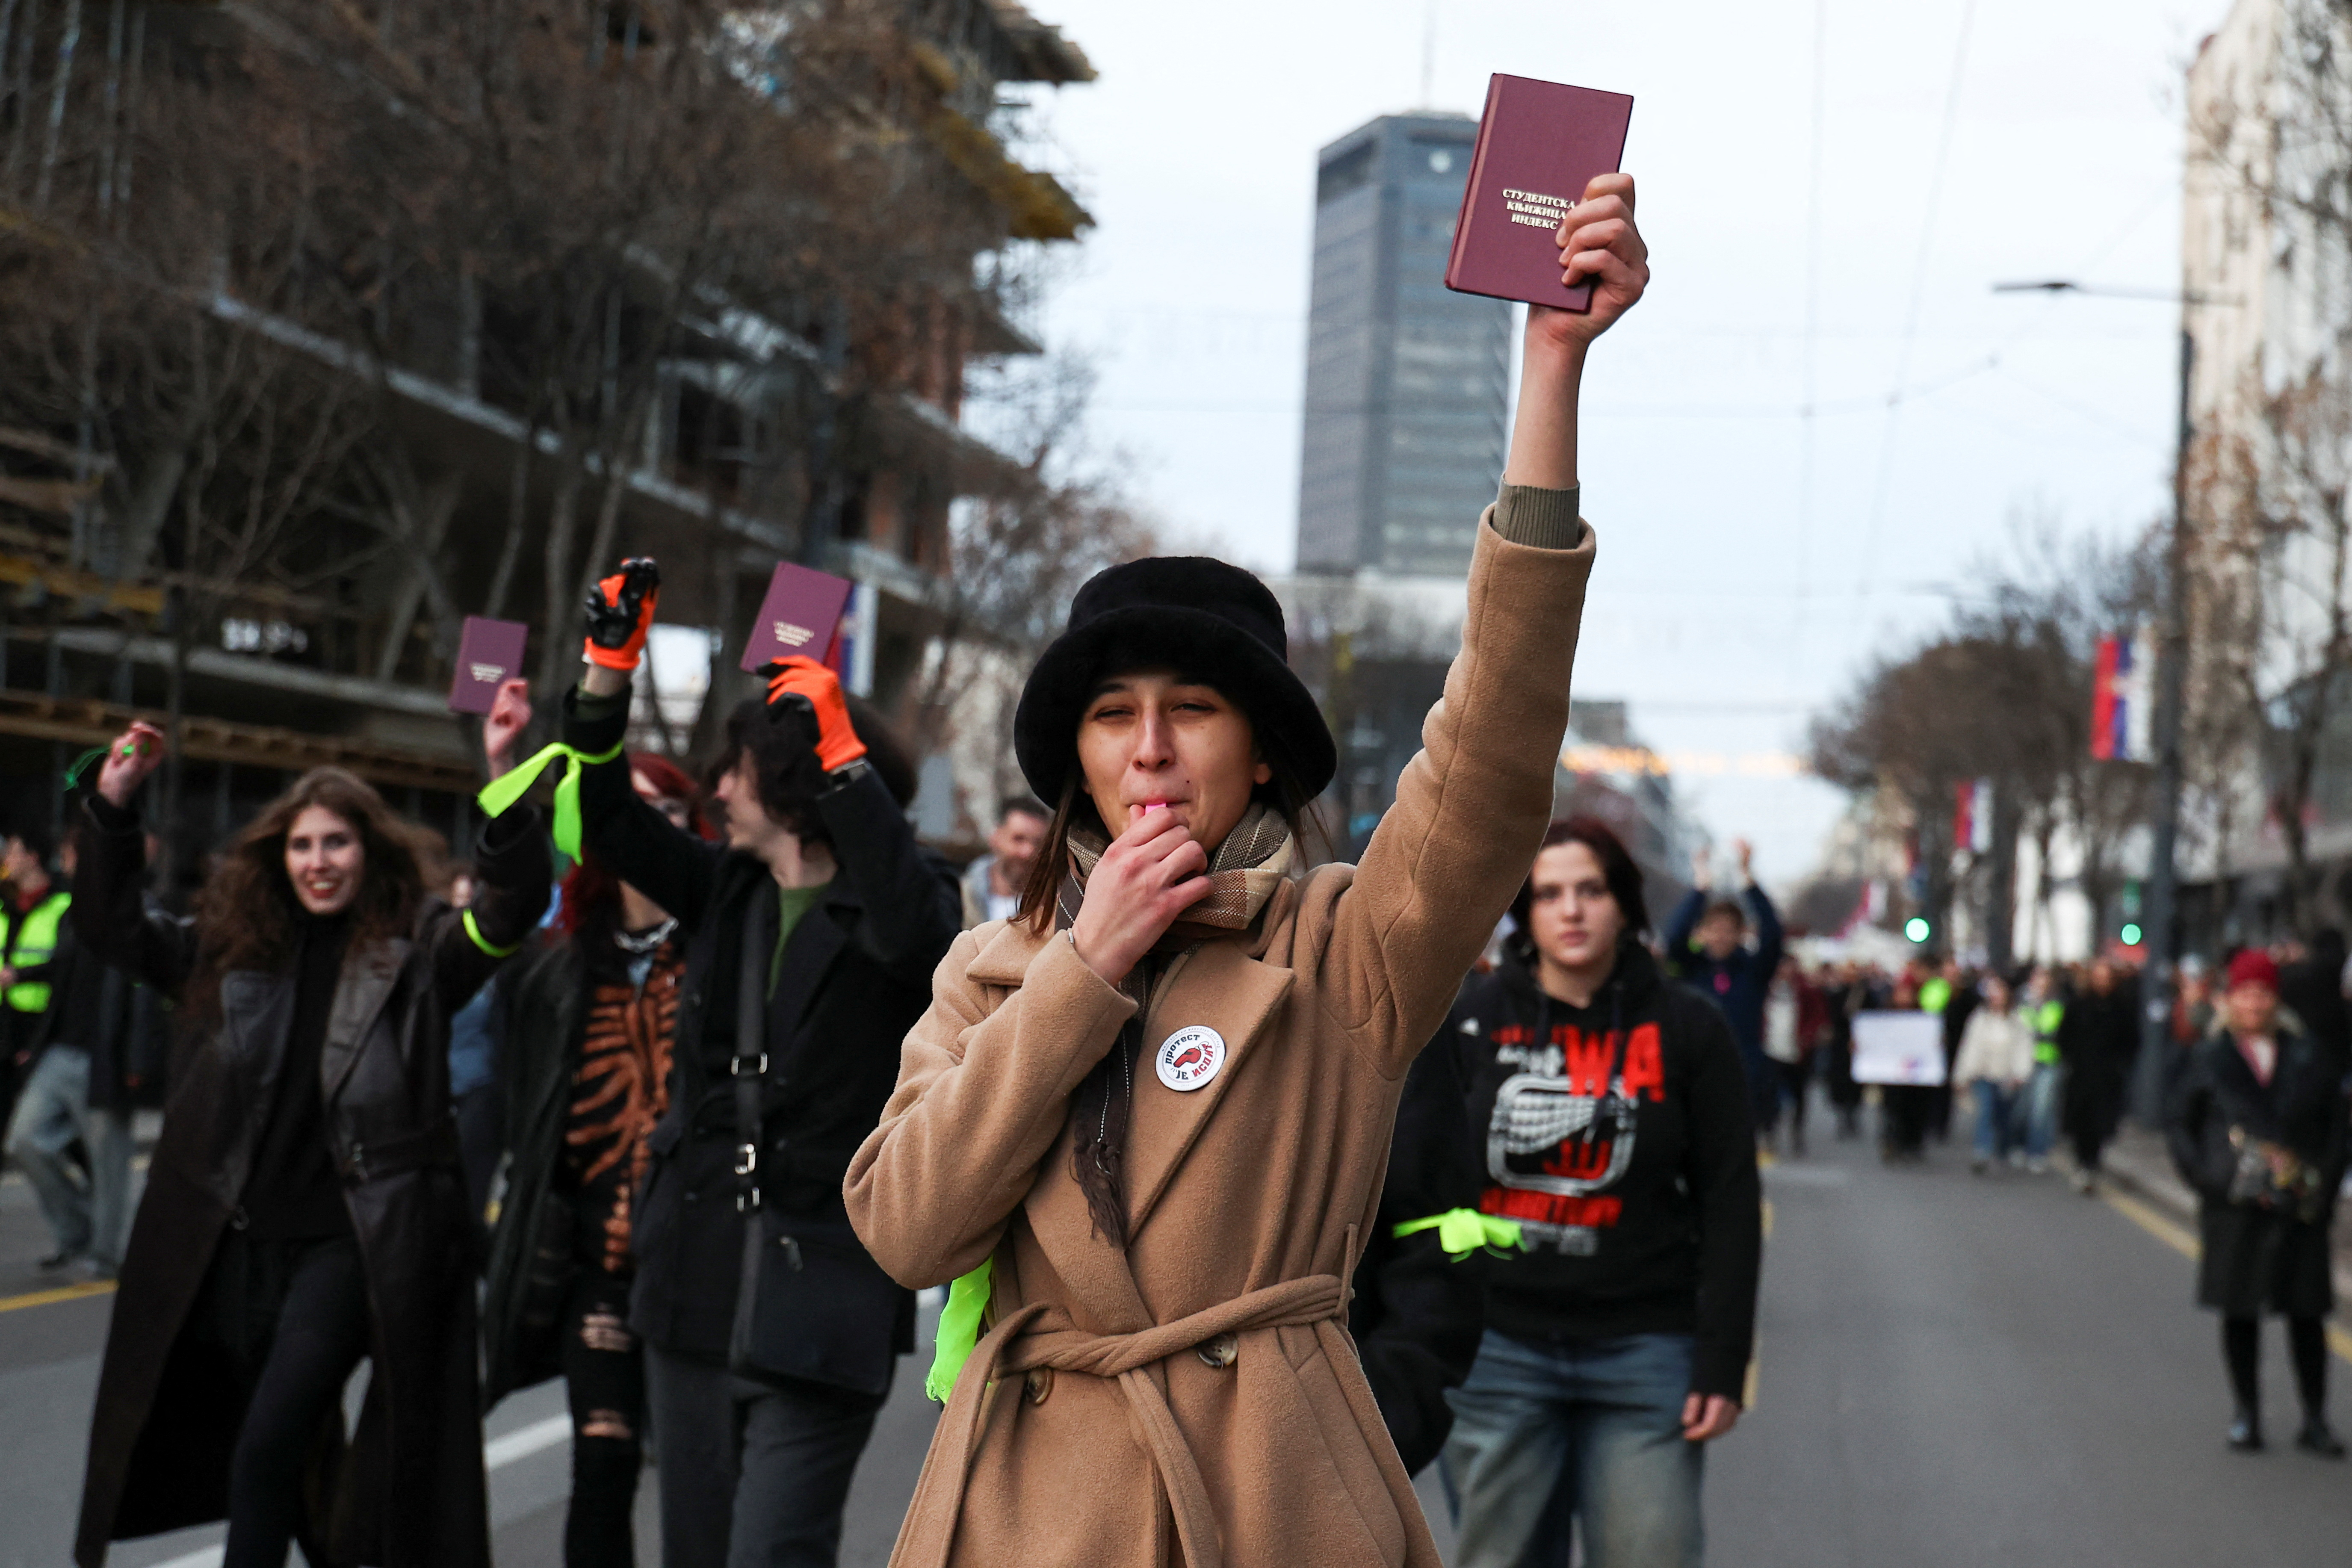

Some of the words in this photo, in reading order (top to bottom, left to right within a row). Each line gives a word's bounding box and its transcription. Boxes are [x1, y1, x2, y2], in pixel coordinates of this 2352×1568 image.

[1502, 189, 1575, 209] СТУДЕНТСКА
[1506, 201, 1566, 220] КЊИЖИЦА
[1511, 213, 1559, 230] ИНДЕКС
